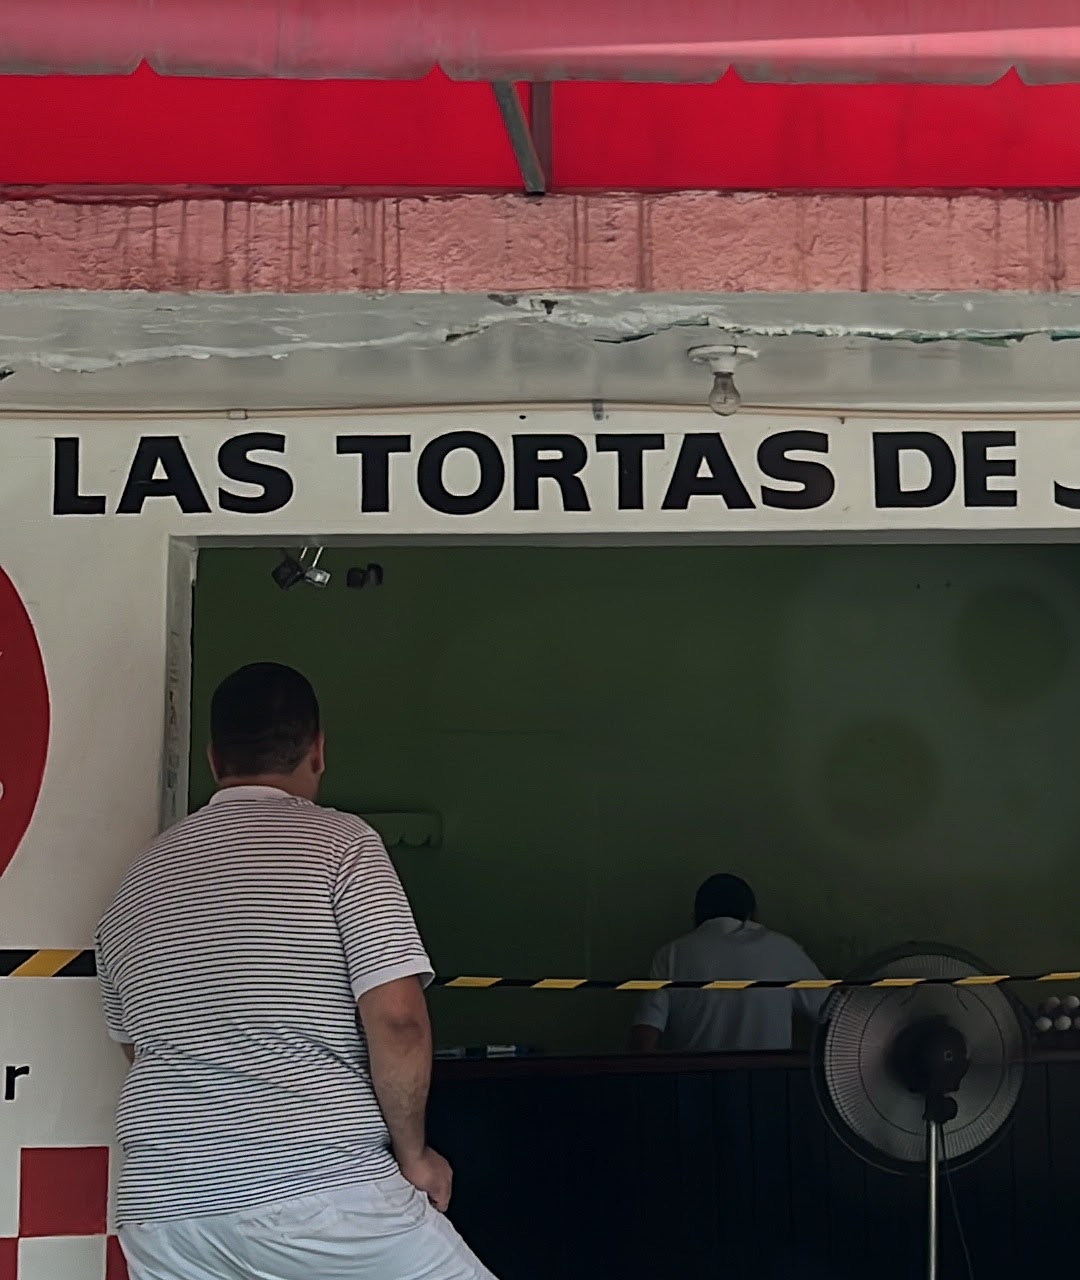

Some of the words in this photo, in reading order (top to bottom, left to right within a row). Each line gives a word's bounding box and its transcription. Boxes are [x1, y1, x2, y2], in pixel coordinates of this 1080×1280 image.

[52, 432, 296, 516] LAS
[336, 430, 837, 516] TORTAS
[872, 430, 1018, 509] DE
